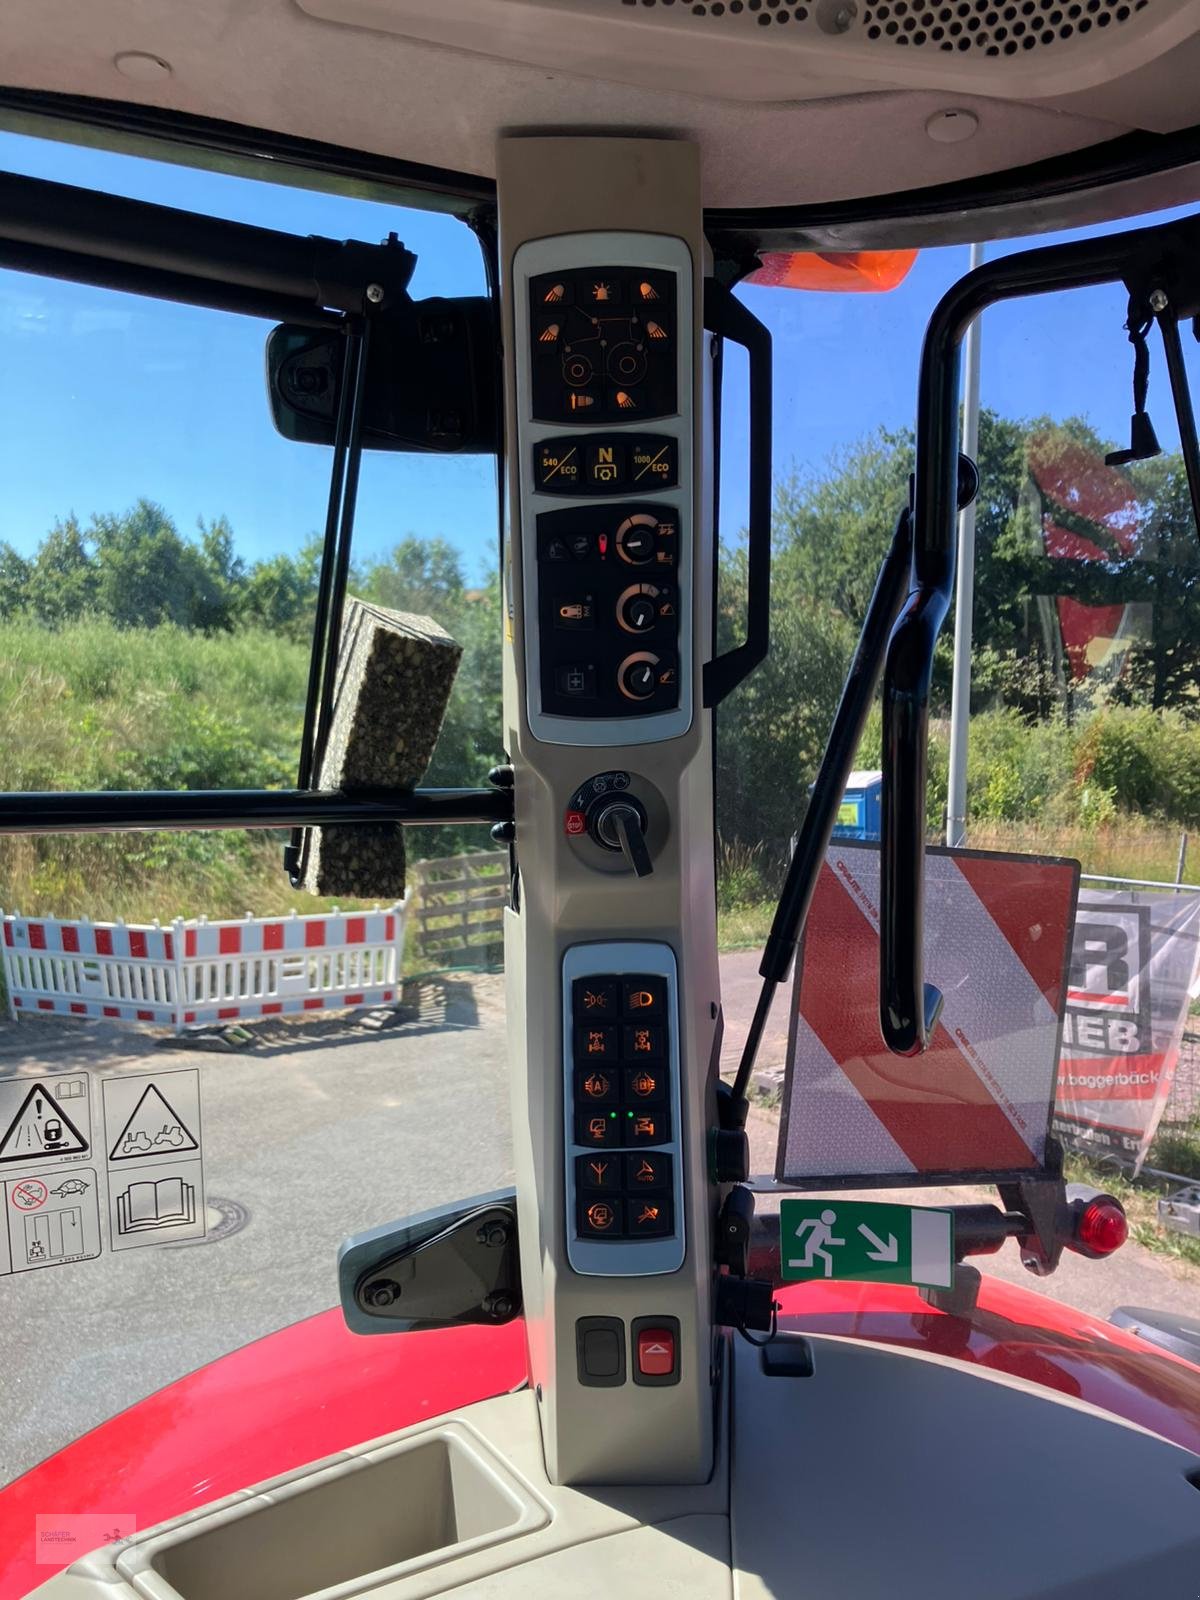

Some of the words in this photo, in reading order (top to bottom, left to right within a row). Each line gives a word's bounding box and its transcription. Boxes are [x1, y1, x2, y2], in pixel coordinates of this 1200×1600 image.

[599, 447, 613, 462] N
[543, 458, 558, 467] 540
[634, 455, 651, 464] 1000
[560, 465, 577, 475] ECO
[652, 463, 669, 472] ECO
